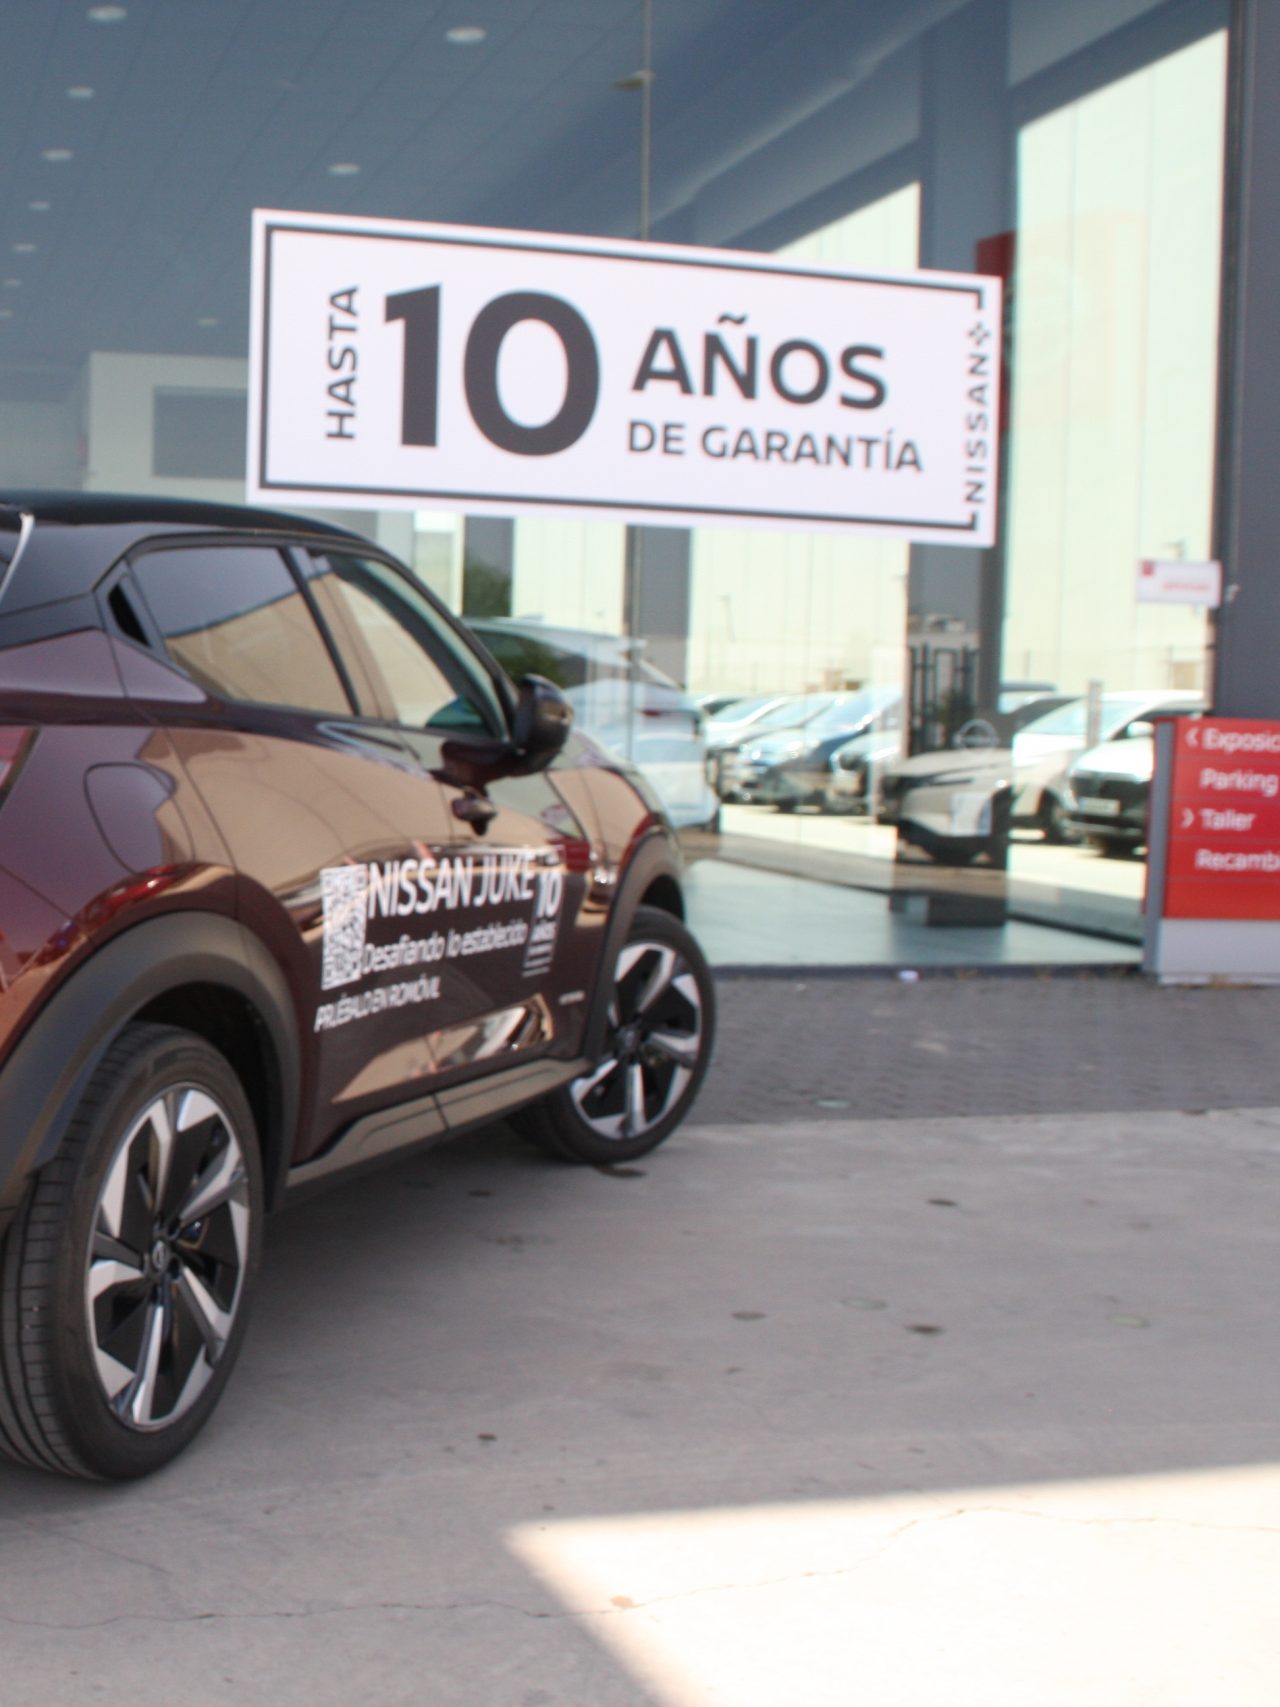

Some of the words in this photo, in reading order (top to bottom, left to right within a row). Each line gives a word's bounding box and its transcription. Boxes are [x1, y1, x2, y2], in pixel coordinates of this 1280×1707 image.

[326, 286, 360, 440] HASTA
[383, 283, 601, 457] 10
[631, 313, 889, 410] AÑOS
[628, 420, 686, 456] DE
[701, 426, 924, 472] GARANTÍA
[964, 349, 990, 504] NISSAN
[1199, 808, 1256, 831] Taller
[1200, 767, 1279, 798] Parking
[368, 856, 474, 919] NISSAN
[473, 851, 537, 907] JUKE
